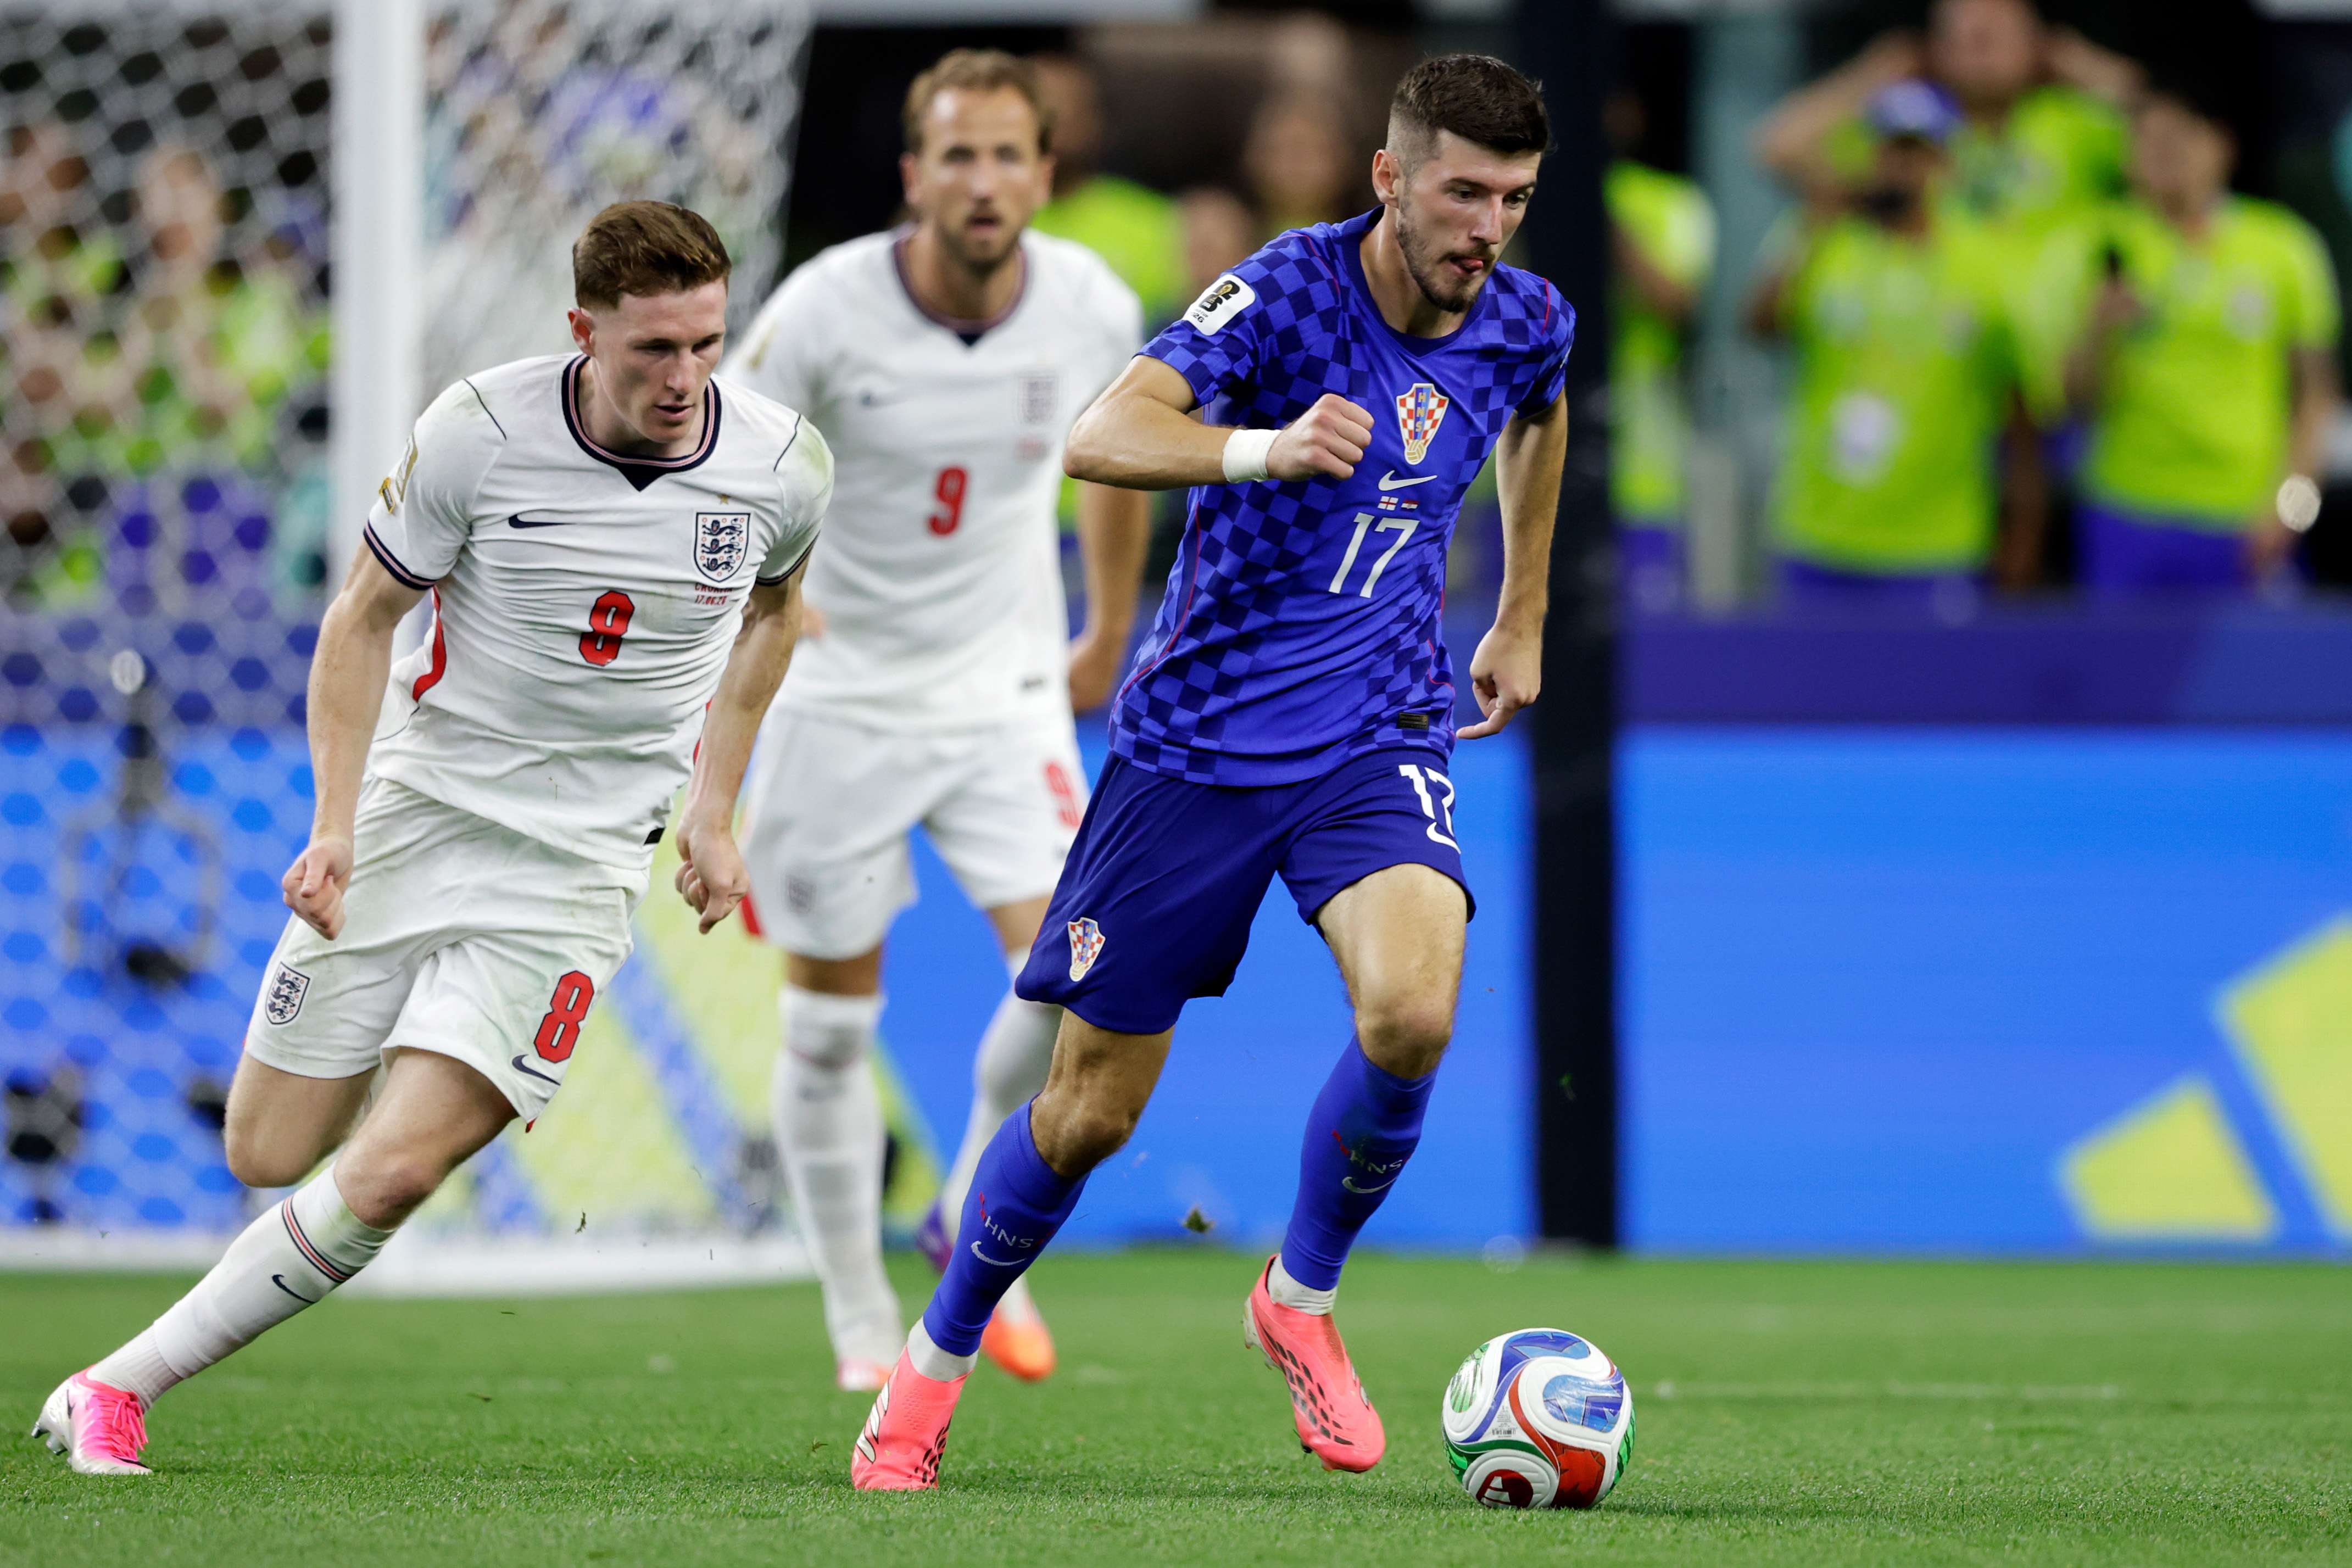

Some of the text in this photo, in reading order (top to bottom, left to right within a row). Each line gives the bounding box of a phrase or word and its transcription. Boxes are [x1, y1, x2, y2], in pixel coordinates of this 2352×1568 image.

[1415, 392, 1427, 432] HNS
[928, 466, 968, 537] 9
[1329, 512, 1420, 598] 17
[579, 590, 635, 666] 8
[1398, 765, 1454, 836] 17
[533, 970, 594, 1063] 8
[1350, 1150, 1403, 1174] HNS
[985, 1215, 1034, 1248] HNS
